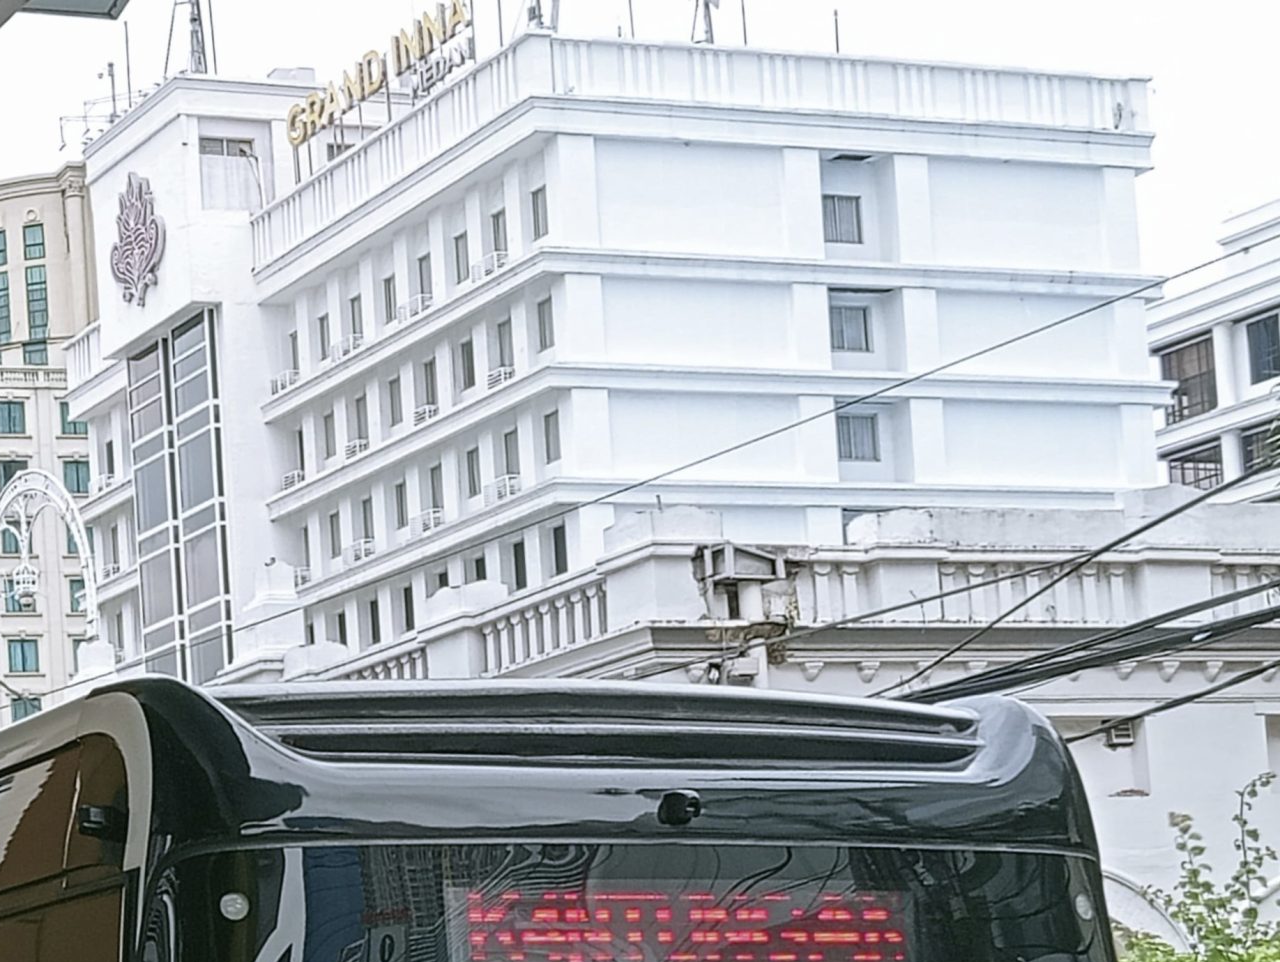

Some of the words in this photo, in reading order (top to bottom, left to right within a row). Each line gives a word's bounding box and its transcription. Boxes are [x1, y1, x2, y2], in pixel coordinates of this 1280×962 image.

[287, 50, 387, 147] GRAND
[390, 0, 472, 77] INNA
[409, 37, 475, 98] MEDAN
